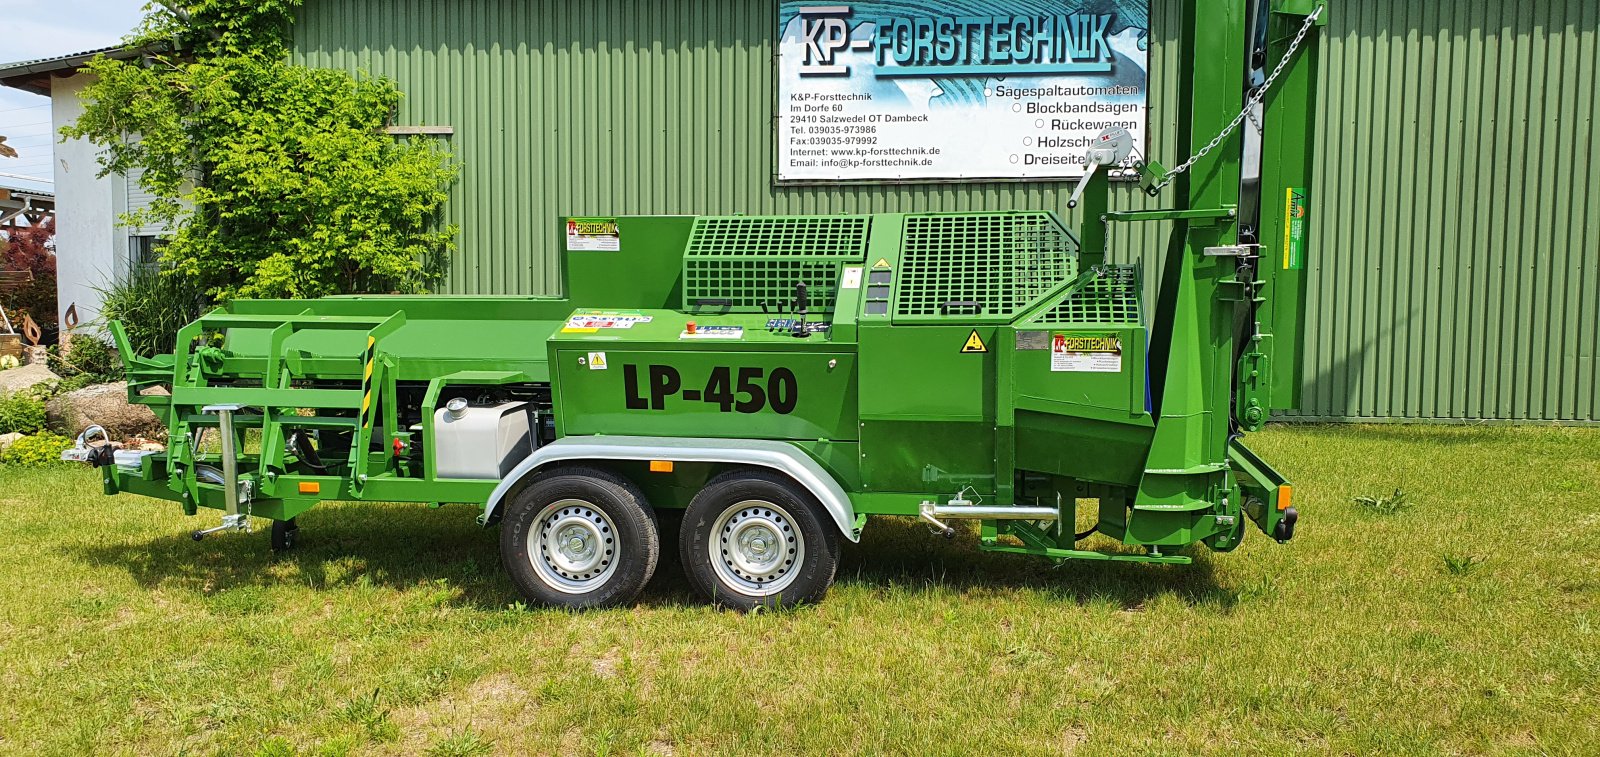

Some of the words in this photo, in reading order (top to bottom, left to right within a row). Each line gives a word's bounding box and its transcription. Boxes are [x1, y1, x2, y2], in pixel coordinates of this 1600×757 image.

[790, 93, 872, 101] K&P-Forsttechnik
[996, 85, 1138, 99] Sägespaltautomaten
[804, 104, 829, 112] Dorfe
[832, 104, 843, 112] 60
[1026, 102, 1138, 115] Blockbandsägen
[790, 115, 817, 123] 29410
[820, 115, 866, 123] Salzwedel
[868, 114, 882, 122] OT
[885, 114, 928, 122] Dambeck
[790, 126, 806, 134] Tel.
[808, 126, 877, 134] 039035-973986
[790, 137, 878, 145] Fax:039035-979992
[790, 148, 828, 156] Internet:
[831, 147, 941, 157] www.kp-forsttechnik.de
[790, 159, 819, 167] Email:
[821, 158, 933, 168] info@kp-forsttechnik.de
[623, 364, 798, 415] LP-450
[512, 501, 535, 548] ROAD
